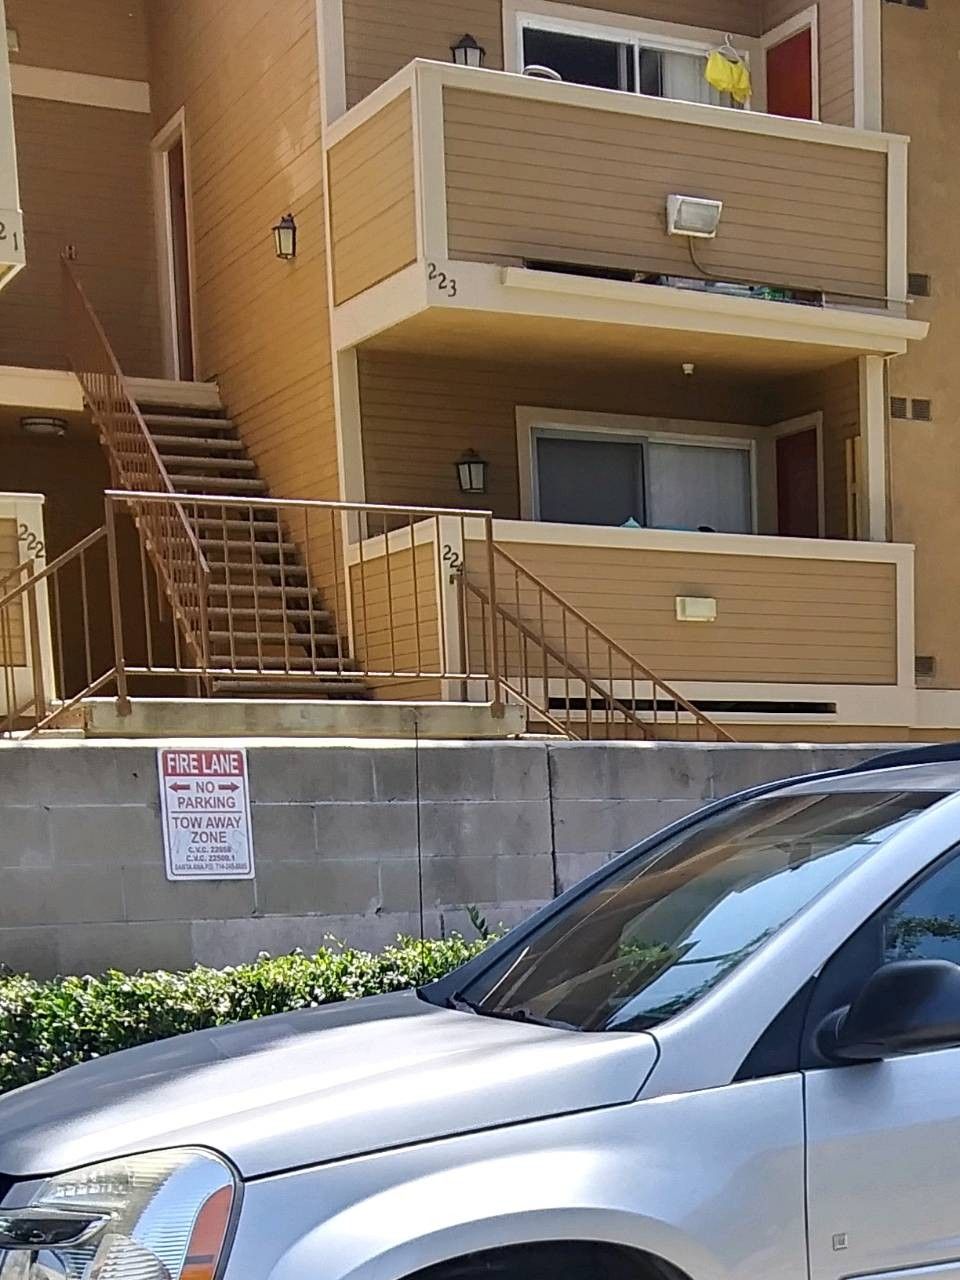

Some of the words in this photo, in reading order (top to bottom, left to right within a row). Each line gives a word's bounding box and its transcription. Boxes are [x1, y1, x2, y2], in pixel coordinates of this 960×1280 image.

[428, 262, 457, 297] 223
[19, 523, 44, 559] 222
[167, 753, 199, 774] FIRE
[201, 753, 240, 774] LANE
[195, 781, 215, 794] NO
[177, 796, 236, 809] PARKING
[171, 816, 202, 829] TOW
[205, 816, 242, 829] AWAY
[191, 831, 227, 844] ZONE
